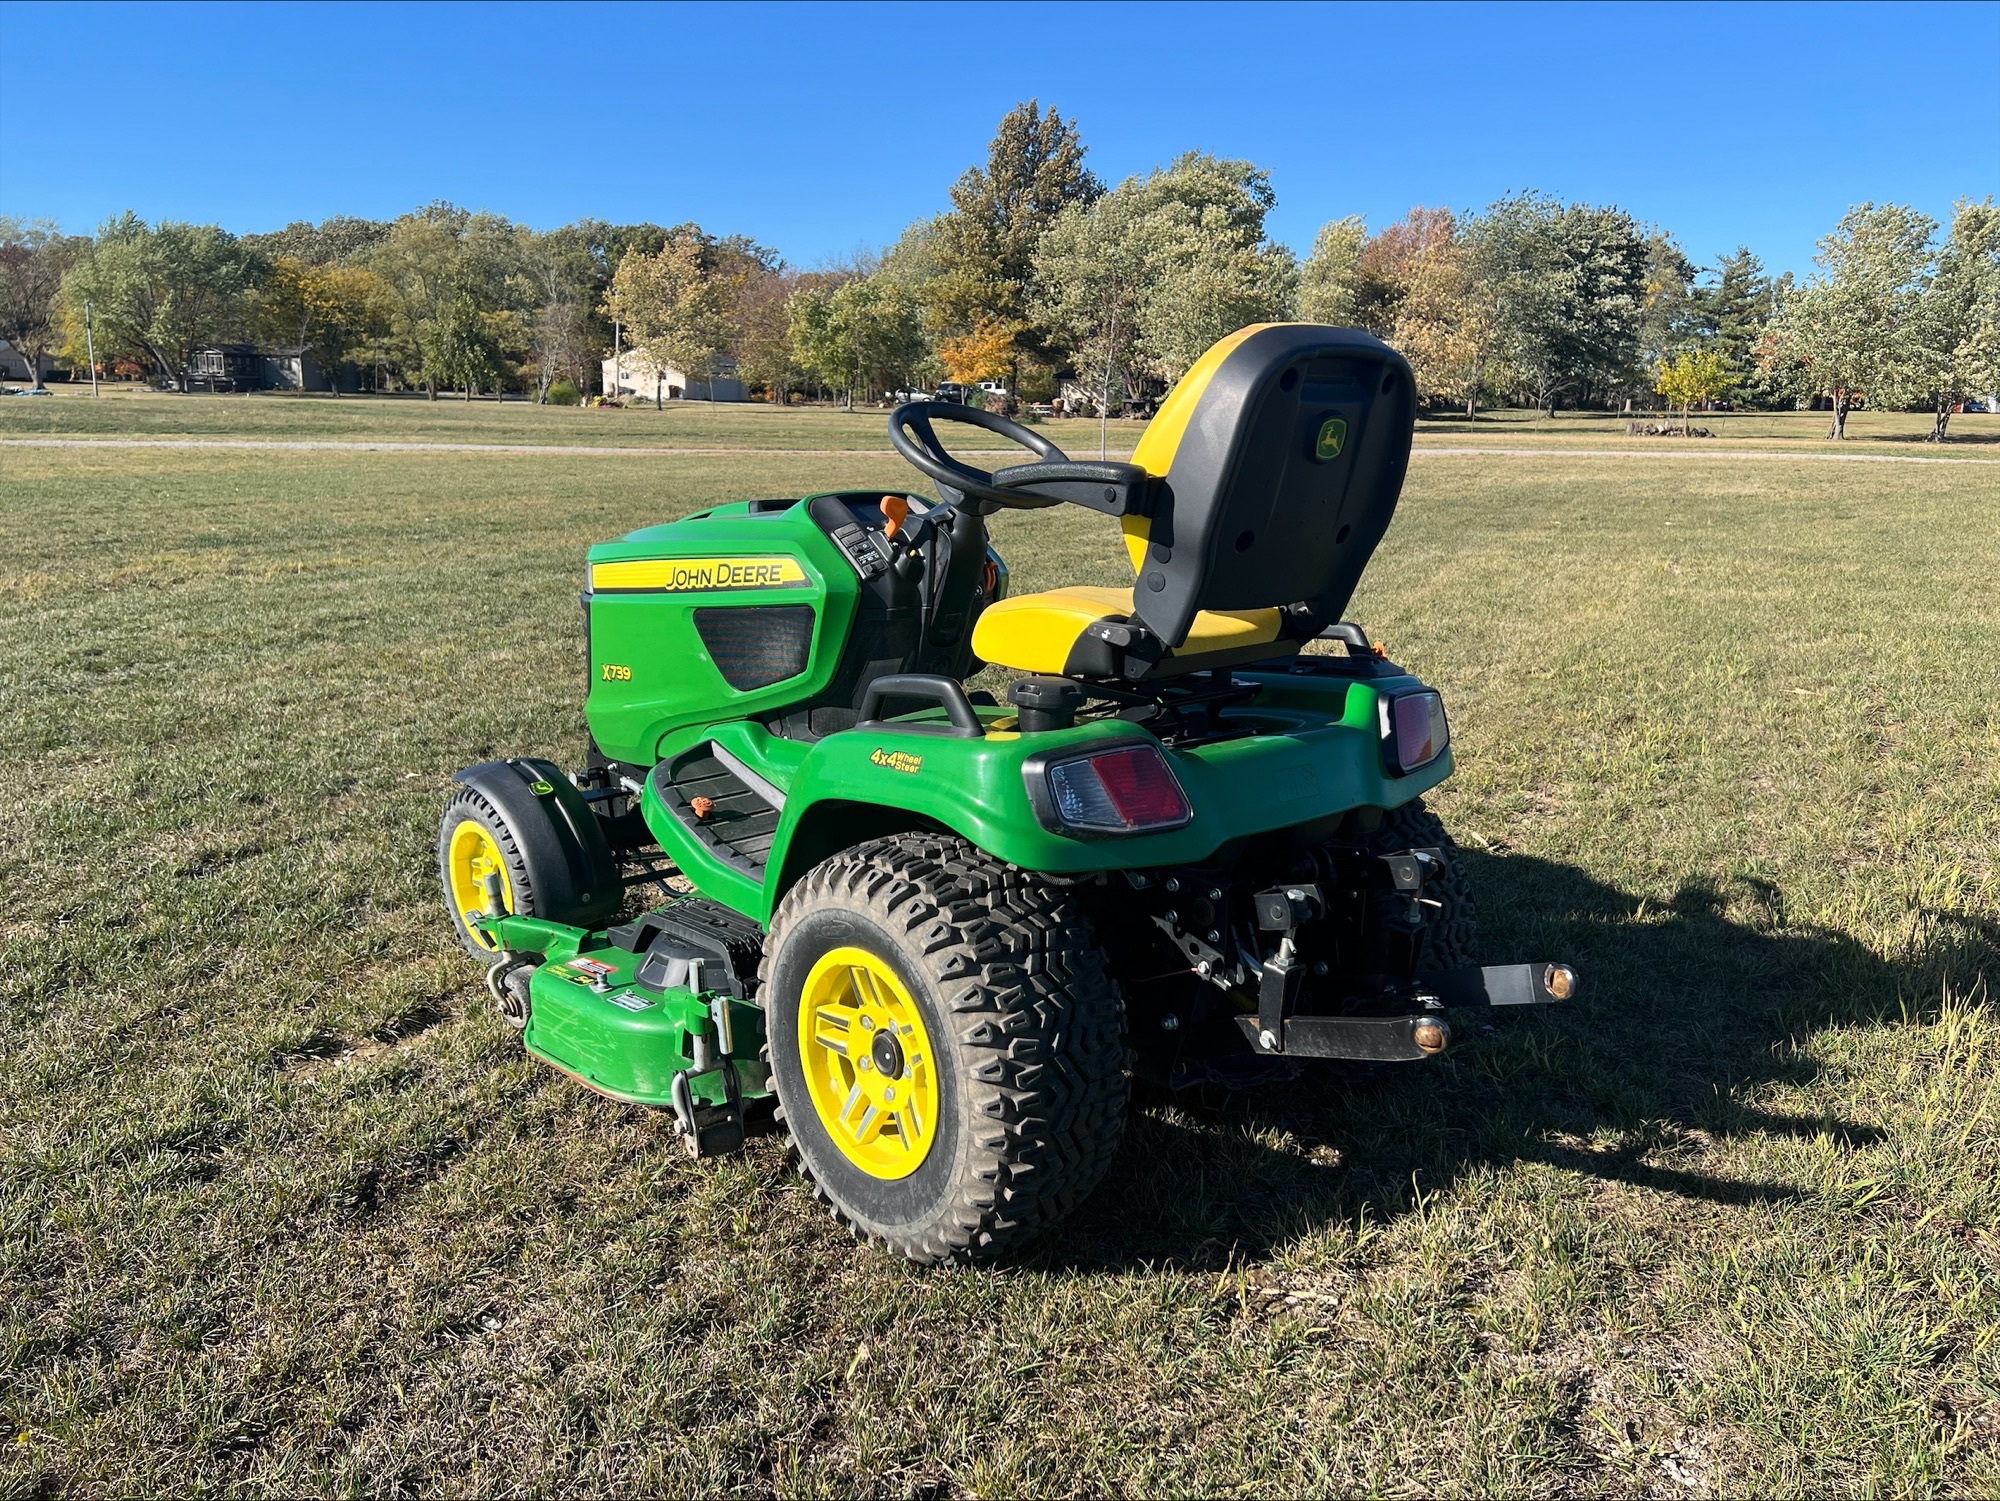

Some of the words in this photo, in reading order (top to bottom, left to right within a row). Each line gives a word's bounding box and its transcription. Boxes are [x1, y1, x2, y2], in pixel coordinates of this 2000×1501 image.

[666, 566, 713, 588] JOHN
[716, 563, 782, 585] DEERE
[602, 664, 632, 682] X739
[870, 748, 897, 767] 4x4
[897, 751, 922, 765] Wheel
[895, 761, 919, 773] Steer
